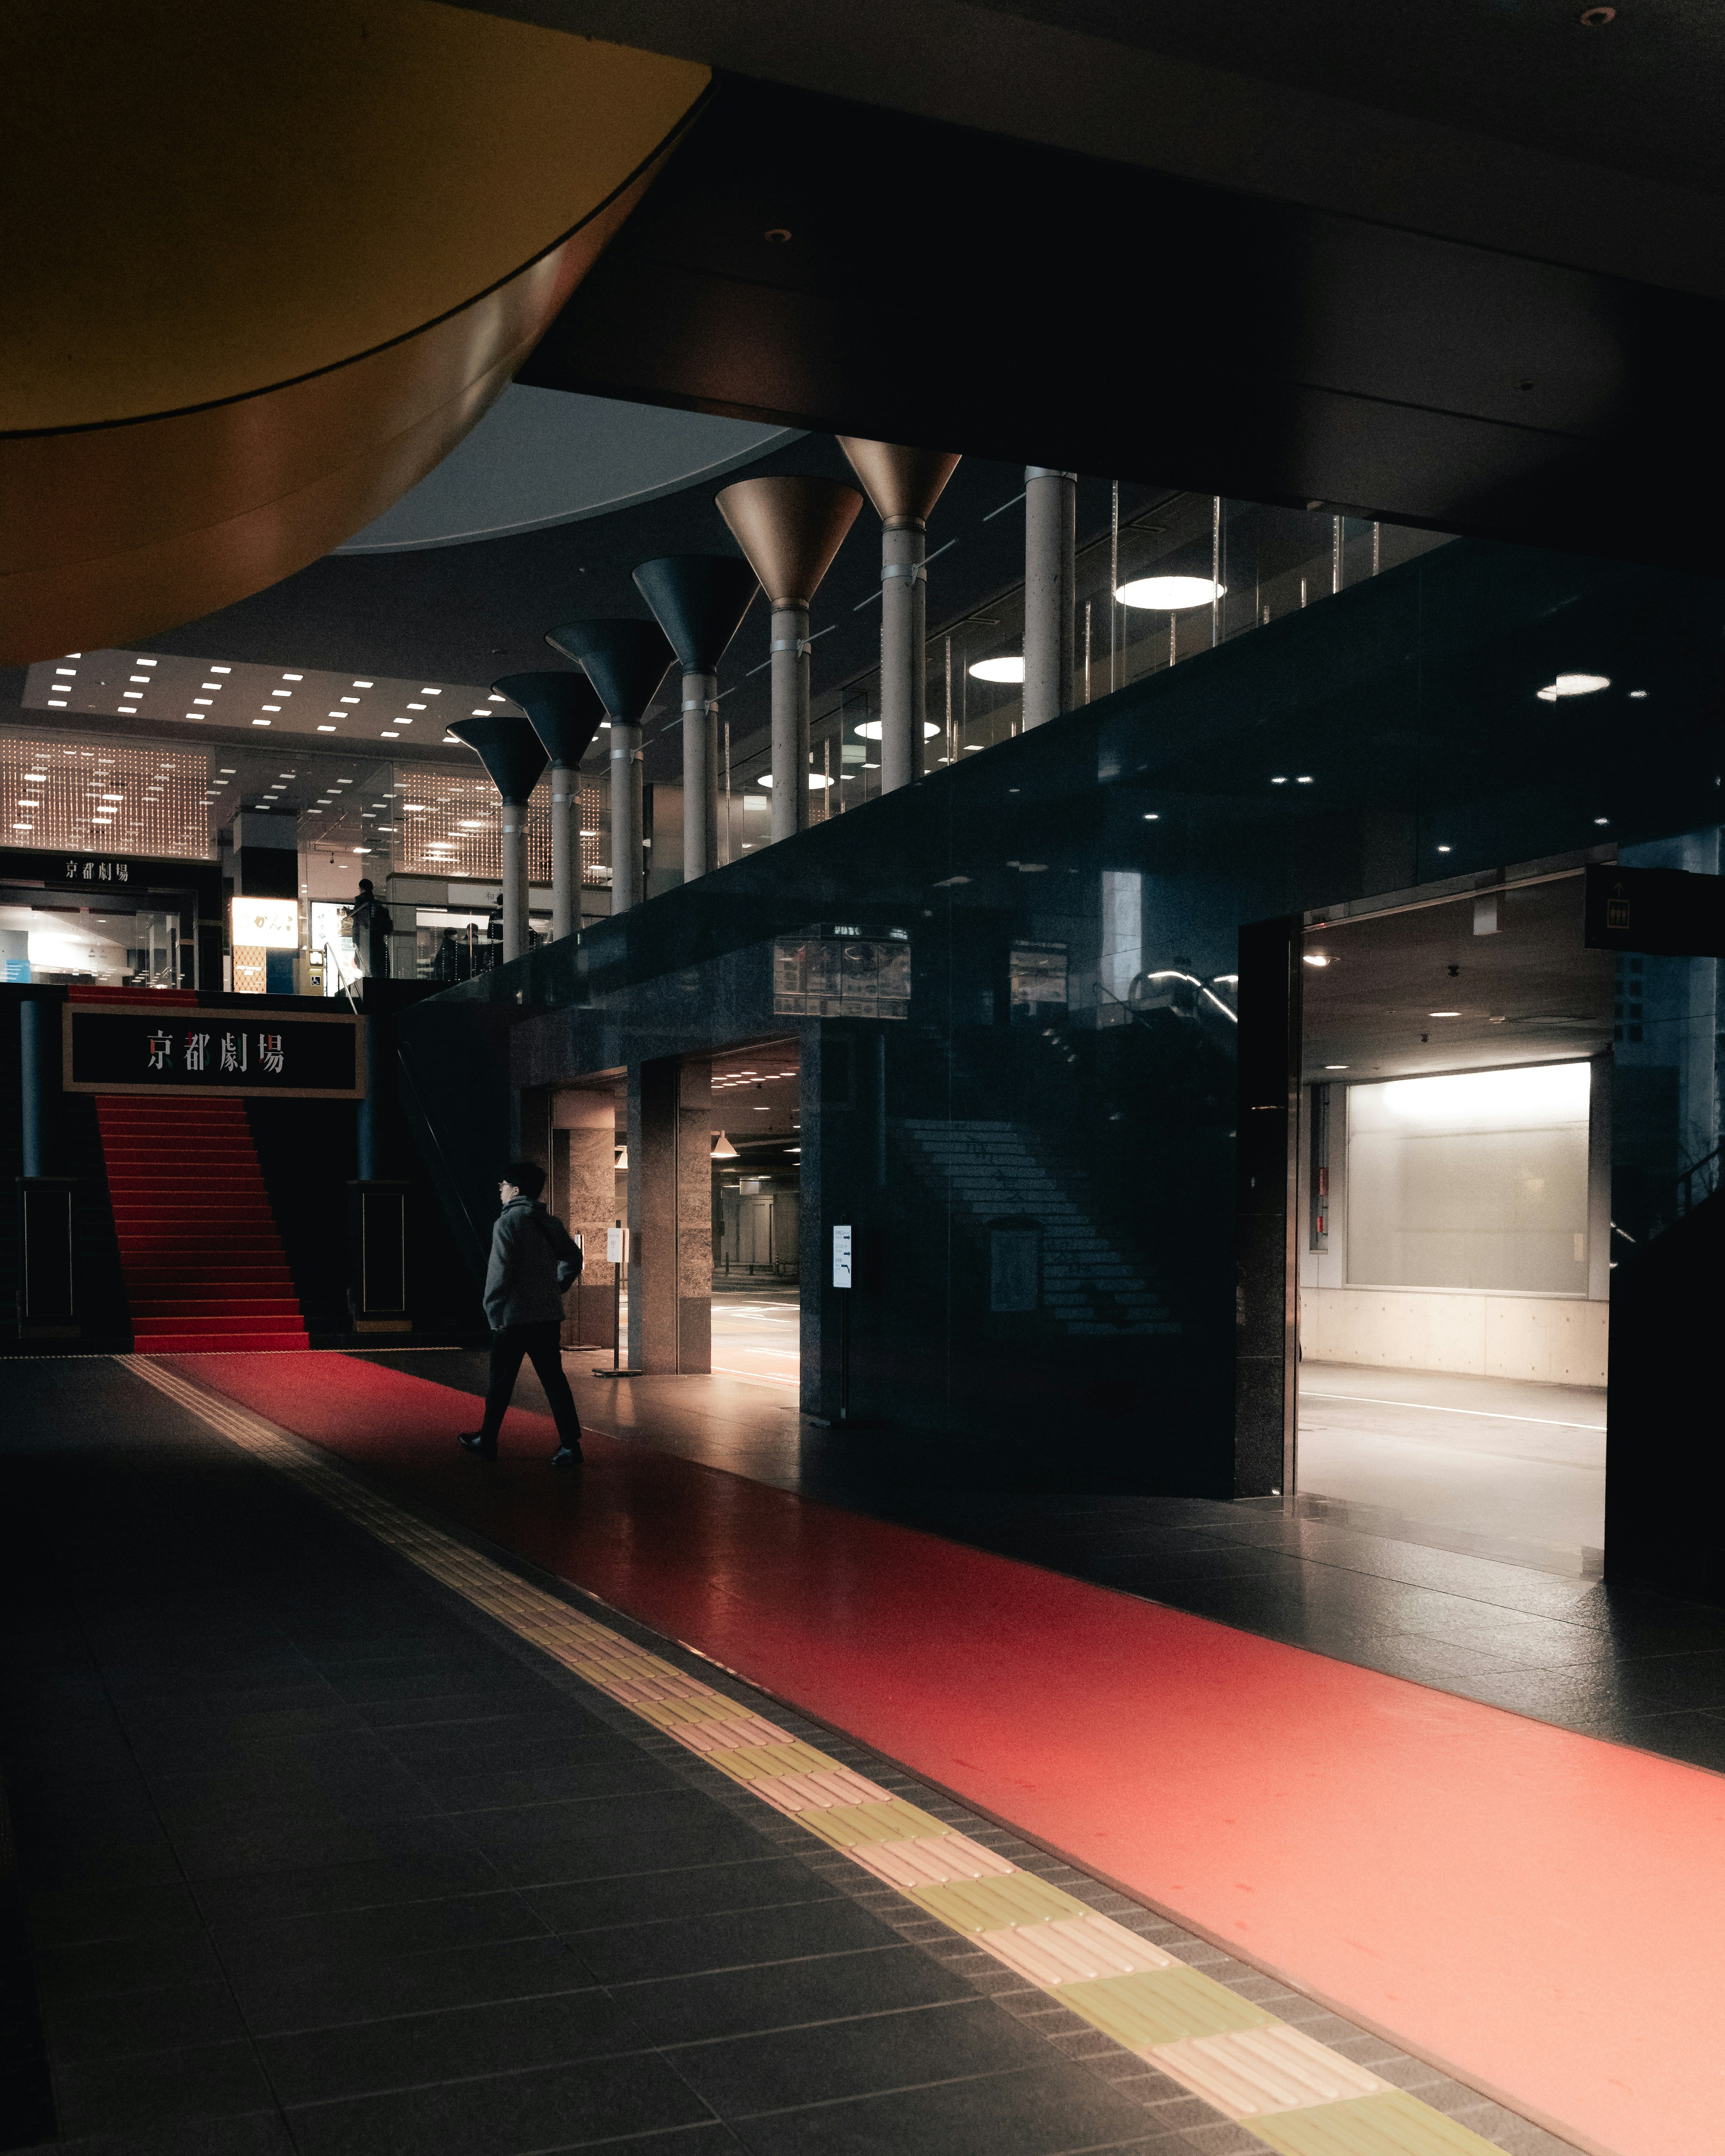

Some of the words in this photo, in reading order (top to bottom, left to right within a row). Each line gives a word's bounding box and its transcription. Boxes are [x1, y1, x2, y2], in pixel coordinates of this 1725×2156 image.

[66, 860, 128, 882] 京都劇場
[146, 1029, 284, 1074] 京都劇場
